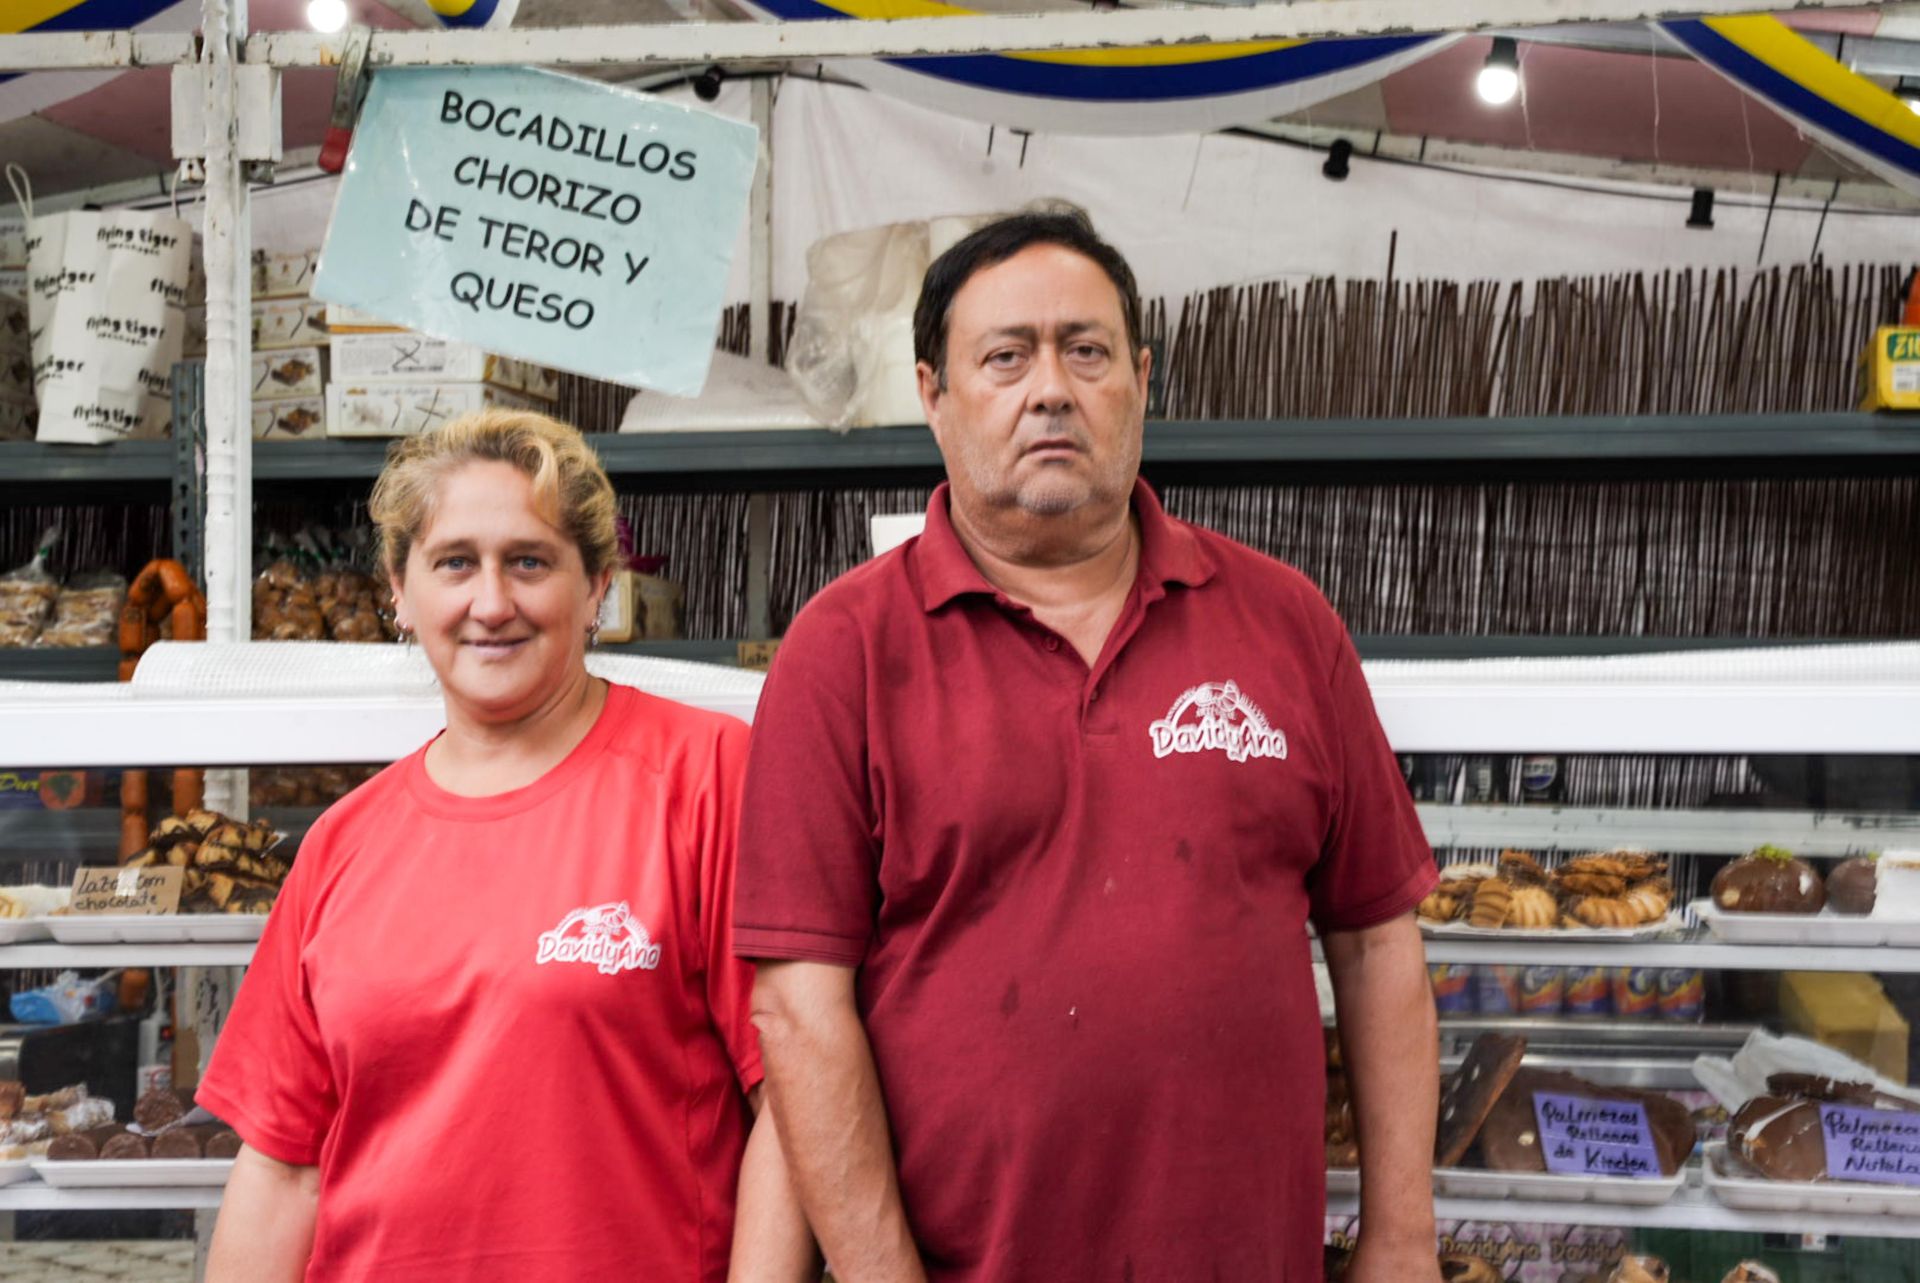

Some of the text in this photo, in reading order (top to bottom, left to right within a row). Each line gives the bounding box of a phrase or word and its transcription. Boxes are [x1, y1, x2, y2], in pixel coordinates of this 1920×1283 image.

[440, 90, 697, 181] BOCADILLOS
[454, 156, 642, 225] CHORIZO
[97, 226, 178, 249] flying tiger
[404, 199, 649, 285] DE TEROR Y
[125, 319, 165, 340] tiger
[450, 271, 595, 330] QUESO
